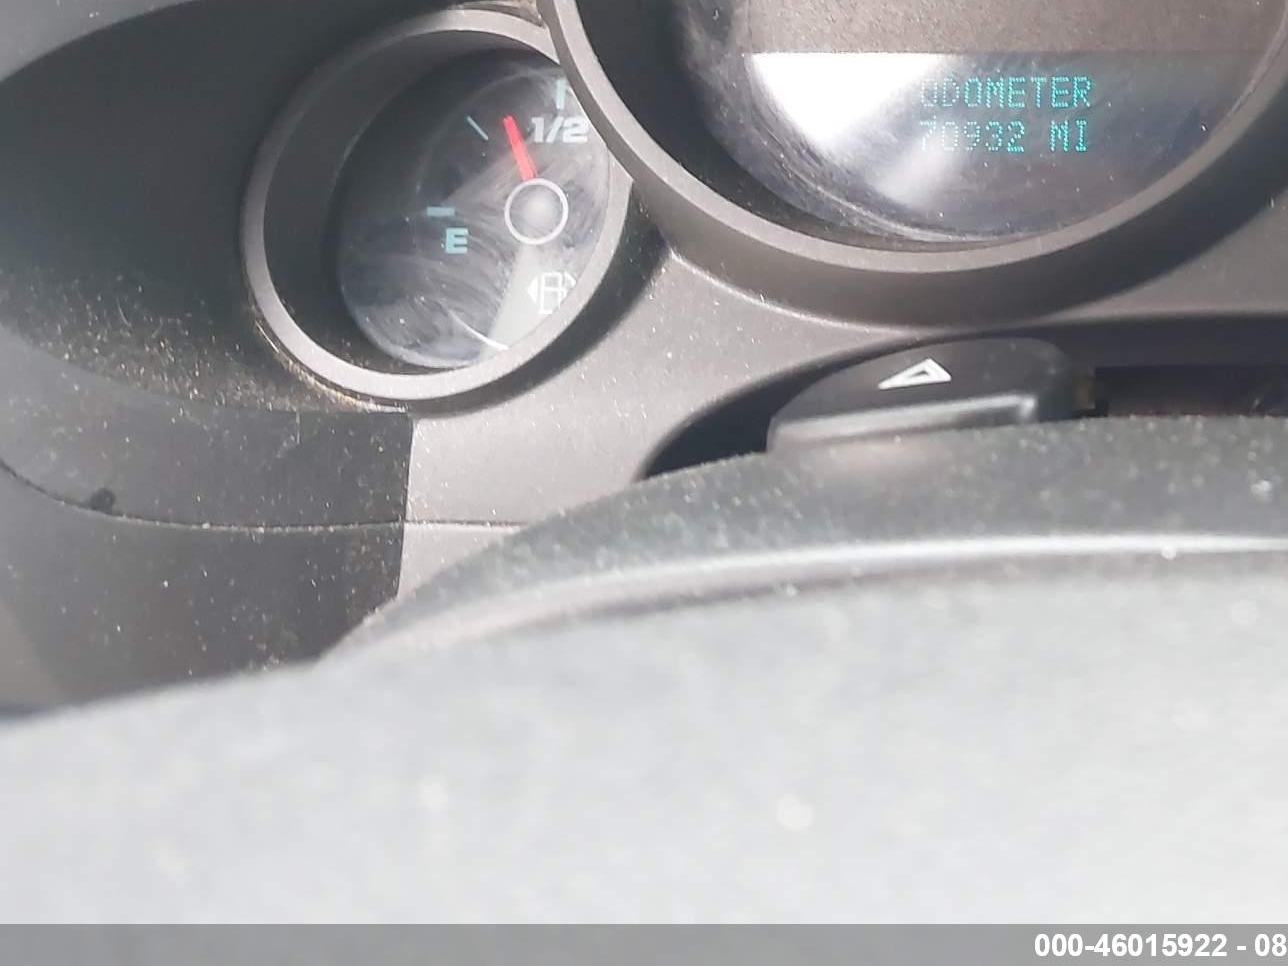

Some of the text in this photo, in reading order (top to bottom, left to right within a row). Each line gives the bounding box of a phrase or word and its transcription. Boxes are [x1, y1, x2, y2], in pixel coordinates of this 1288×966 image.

[920, 77, 1092, 107] ODOMETER
[531, 117, 588, 143] 1/2
[920, 120, 1087, 152] 70932 MI
[444, 228, 468, 254] E
